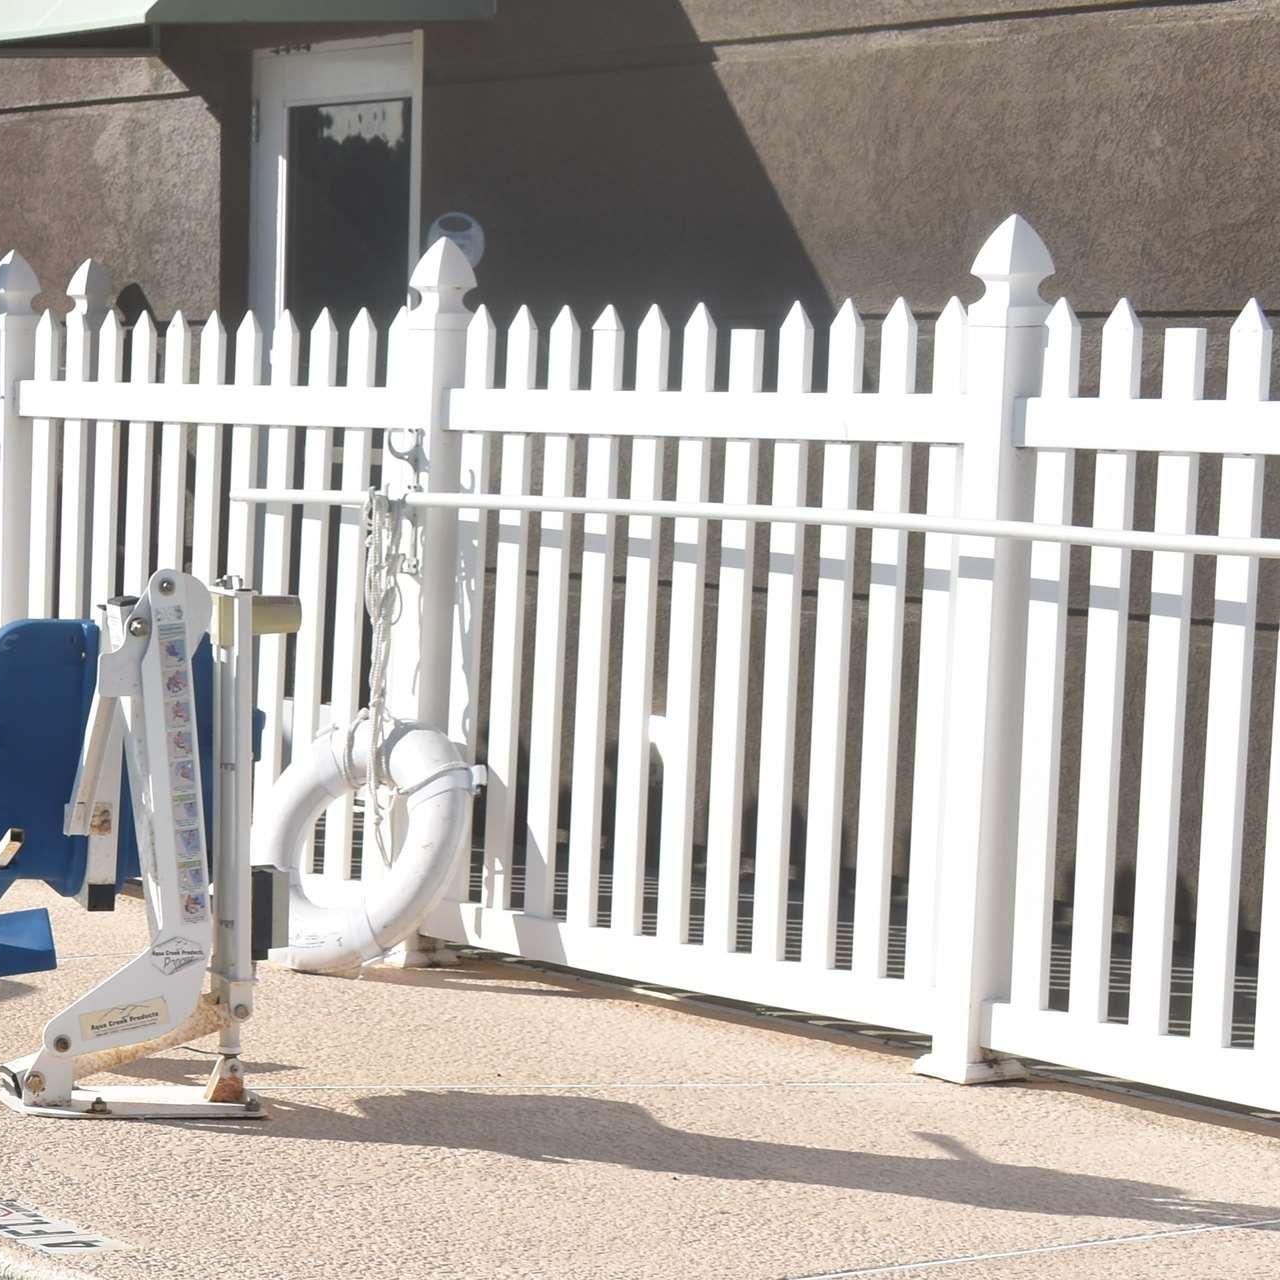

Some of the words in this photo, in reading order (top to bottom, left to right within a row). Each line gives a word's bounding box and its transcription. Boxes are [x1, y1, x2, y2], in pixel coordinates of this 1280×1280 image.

[90, 1024, 107, 1032] Aqua
[108, 1016, 128, 1028] Creek
[129, 1012, 159, 1022] Products
[39, 1240, 102, 1248] 4
